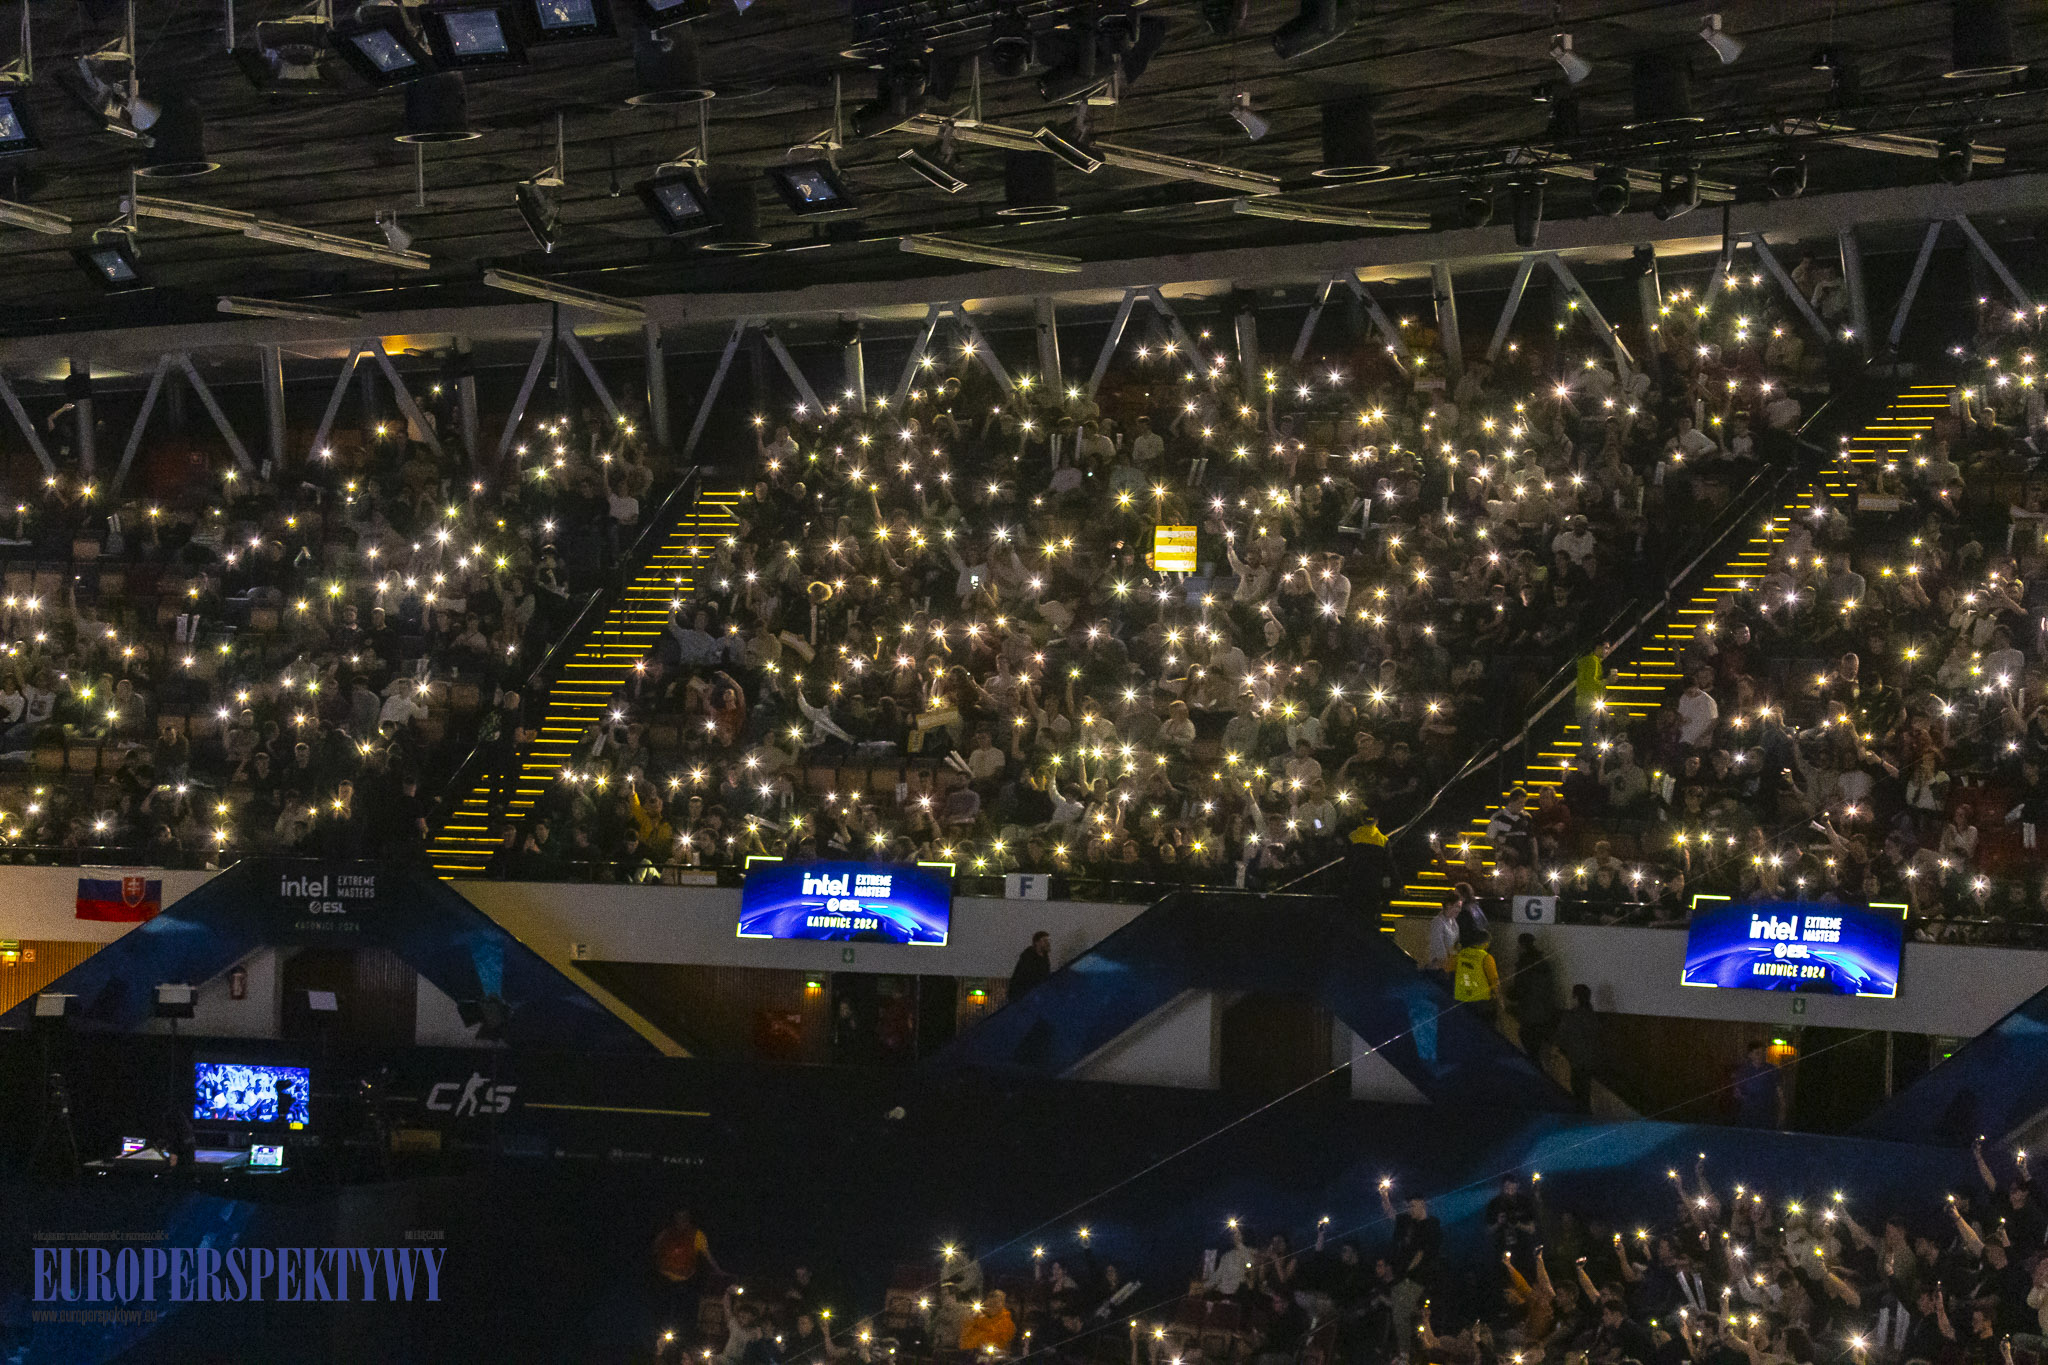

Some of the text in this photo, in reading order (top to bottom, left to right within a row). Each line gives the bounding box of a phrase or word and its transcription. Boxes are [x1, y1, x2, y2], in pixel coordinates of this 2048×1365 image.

[337, 875, 375, 886] EXTREME
[855, 874, 892, 886] EXTREME
[1020, 876, 1034, 897] F
[337, 887, 375, 898] MASTERS
[854, 886, 891, 898] MASTERS
[322, 901, 346, 913] ESL
[1524, 899, 1543, 921] G
[807, 916, 878, 929] KATOWICE 2024
[1805, 916, 1842, 929] EXTREME
[1803, 930, 1841, 943] MASTERS
[1753, 963, 1825, 978] KATOWICE 2024
